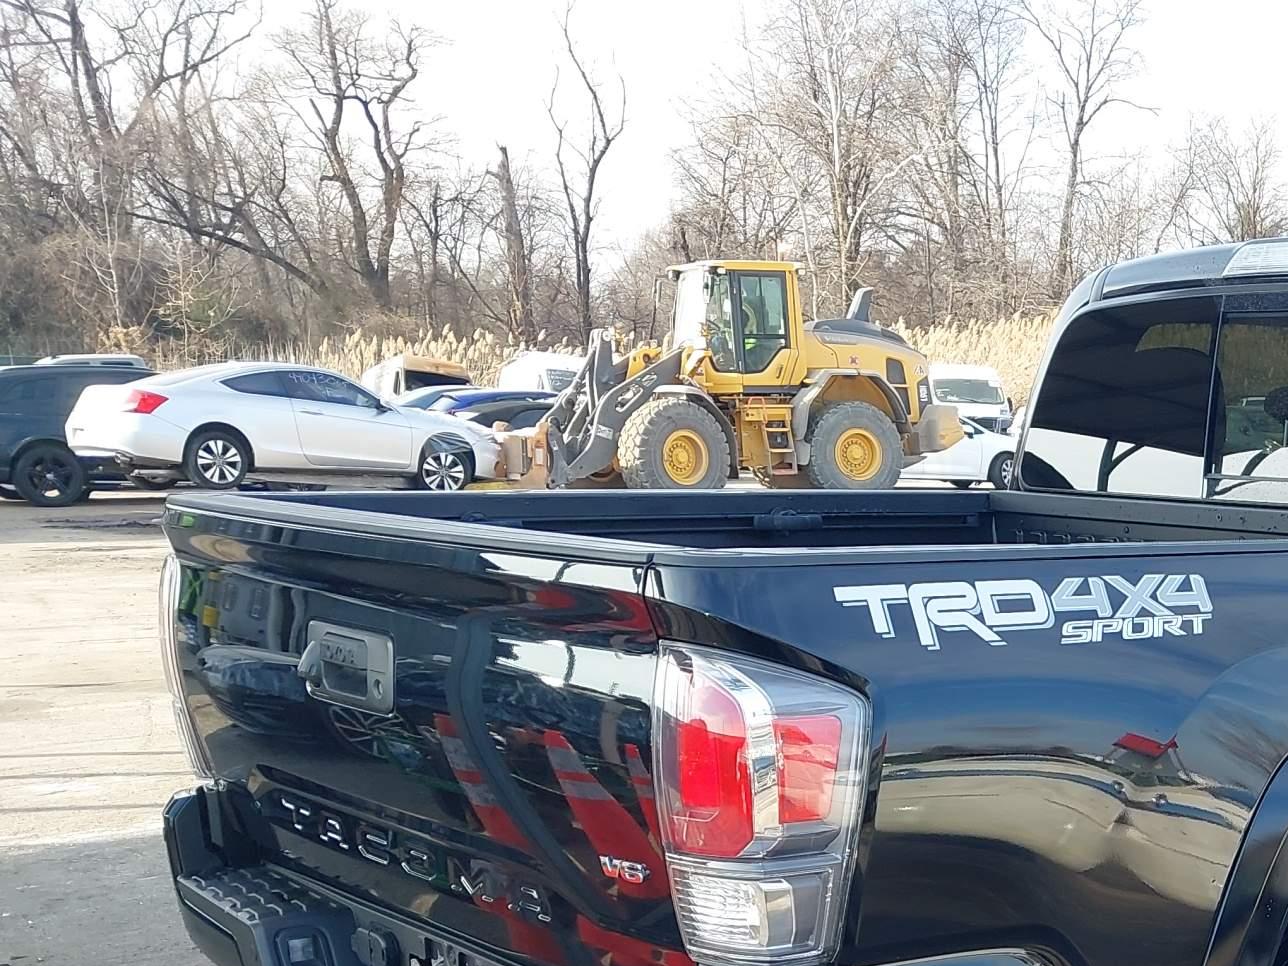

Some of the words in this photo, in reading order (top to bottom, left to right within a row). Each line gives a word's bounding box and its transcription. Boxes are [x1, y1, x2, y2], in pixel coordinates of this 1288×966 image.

[833, 579, 1056, 651] TRD
[1060, 613, 1213, 645] SPORT
[598, 854, 651, 884] V6
